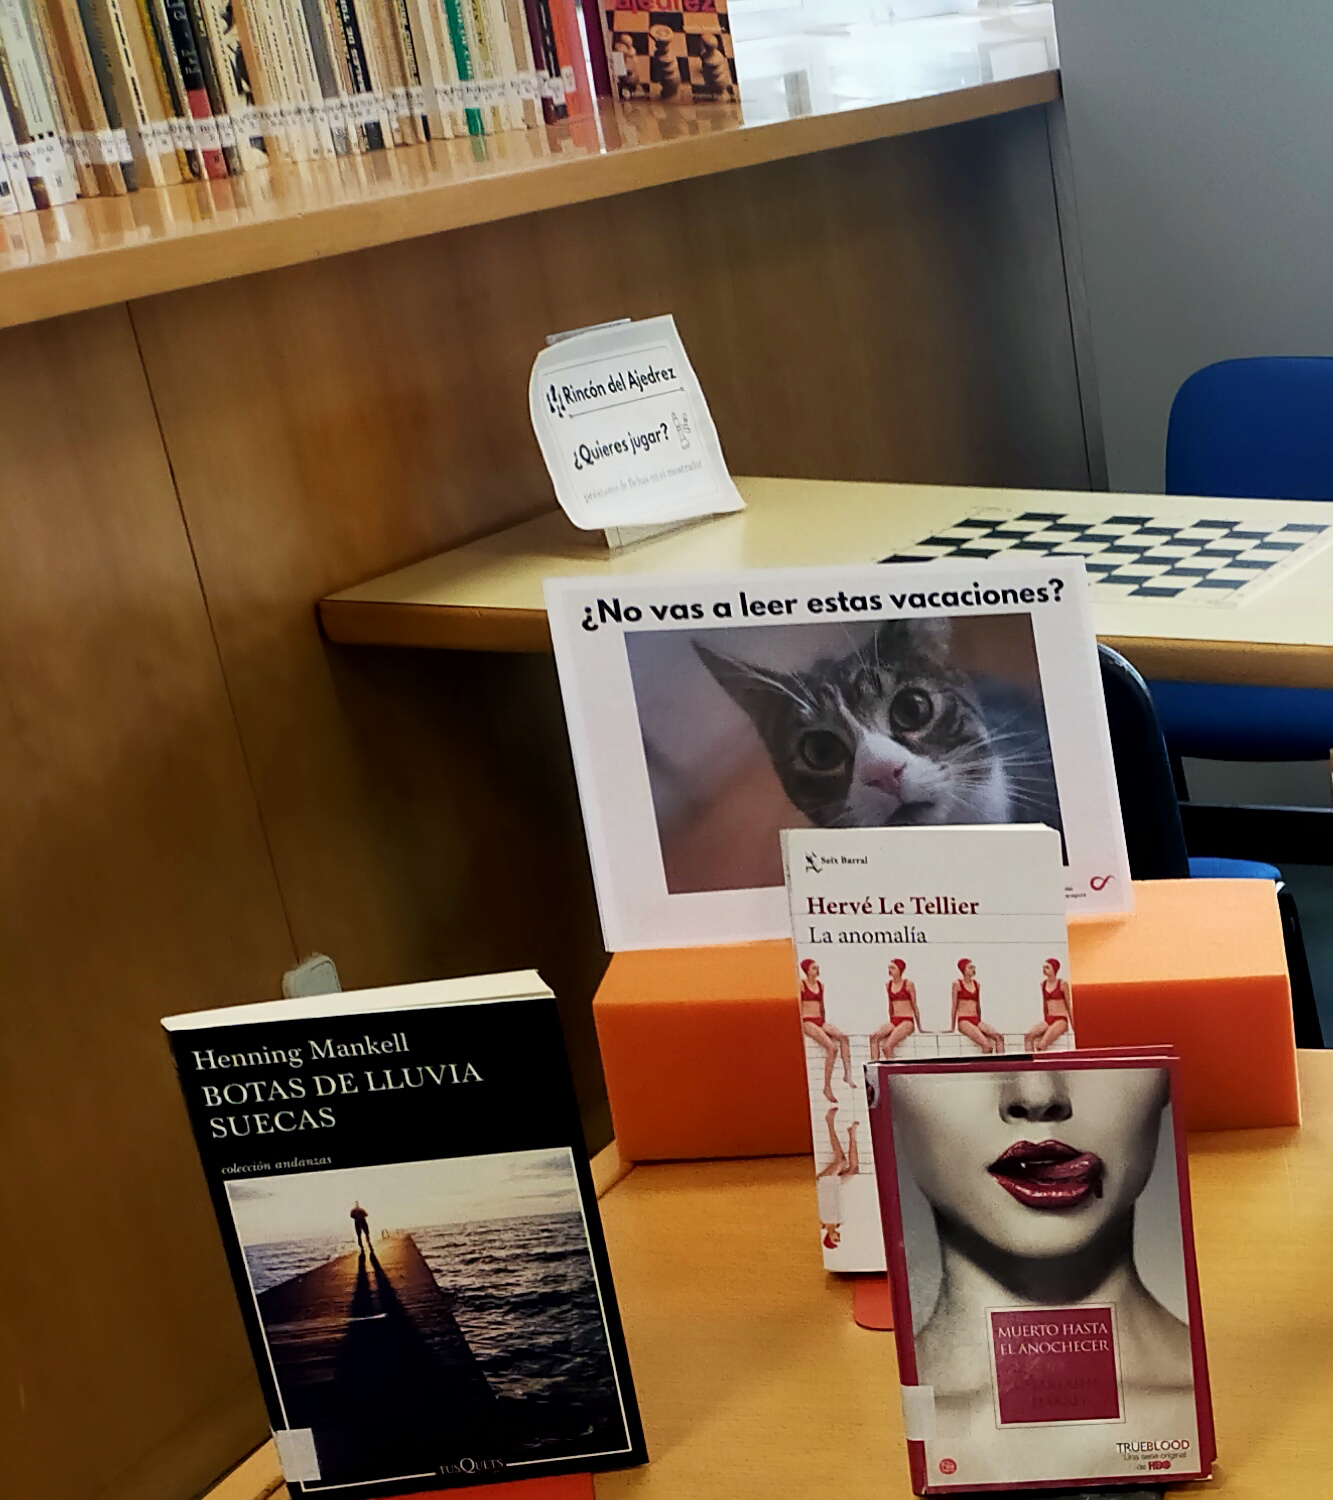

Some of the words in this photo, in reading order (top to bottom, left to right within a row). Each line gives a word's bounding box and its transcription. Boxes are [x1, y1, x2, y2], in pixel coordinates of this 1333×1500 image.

[562, 380, 607, 405] Rincón
[608, 372, 626, 394] del
[628, 365, 677, 392] Ajedrez
[574, 439, 629, 471] ¿Quieres
[628, 422, 669, 455] jugar?
[581, 597, 643, 634] ¿No
[650, 602, 705, 621] vas
[712, 600, 733, 620] a
[740, 591, 799, 618] leer
[806, 589, 883, 616] estas
[892, 578, 1065, 611] vacaciones?
[820, 856, 840, 866] Seix
[841, 854, 868, 866] Barral
[806, 894, 872, 916] Hervé
[878, 896, 906, 916] Le
[908, 896, 980, 916] Tellier
[810, 926, 833, 944] La
[838, 924, 928, 944] anomalía
[192, 1046, 304, 1072] Henning
[308, 1032, 410, 1062] Mankell
[203, 1080, 307, 1108] BOTAS
[312, 1074, 359, 1098] DE
[367, 1063, 484, 1092] LLUVIA
[210, 1107, 337, 1140] SUECAS
[221, 1160, 272, 1176] colección
[274, 1156, 333, 1170] andanzas
[998, 1324, 1059, 1338] MUERTO
[1062, 1322, 1109, 1336] HASTA
[1000, 1343, 1016, 1356] EL
[1019, 1340, 1110, 1356] ANOCHECER
